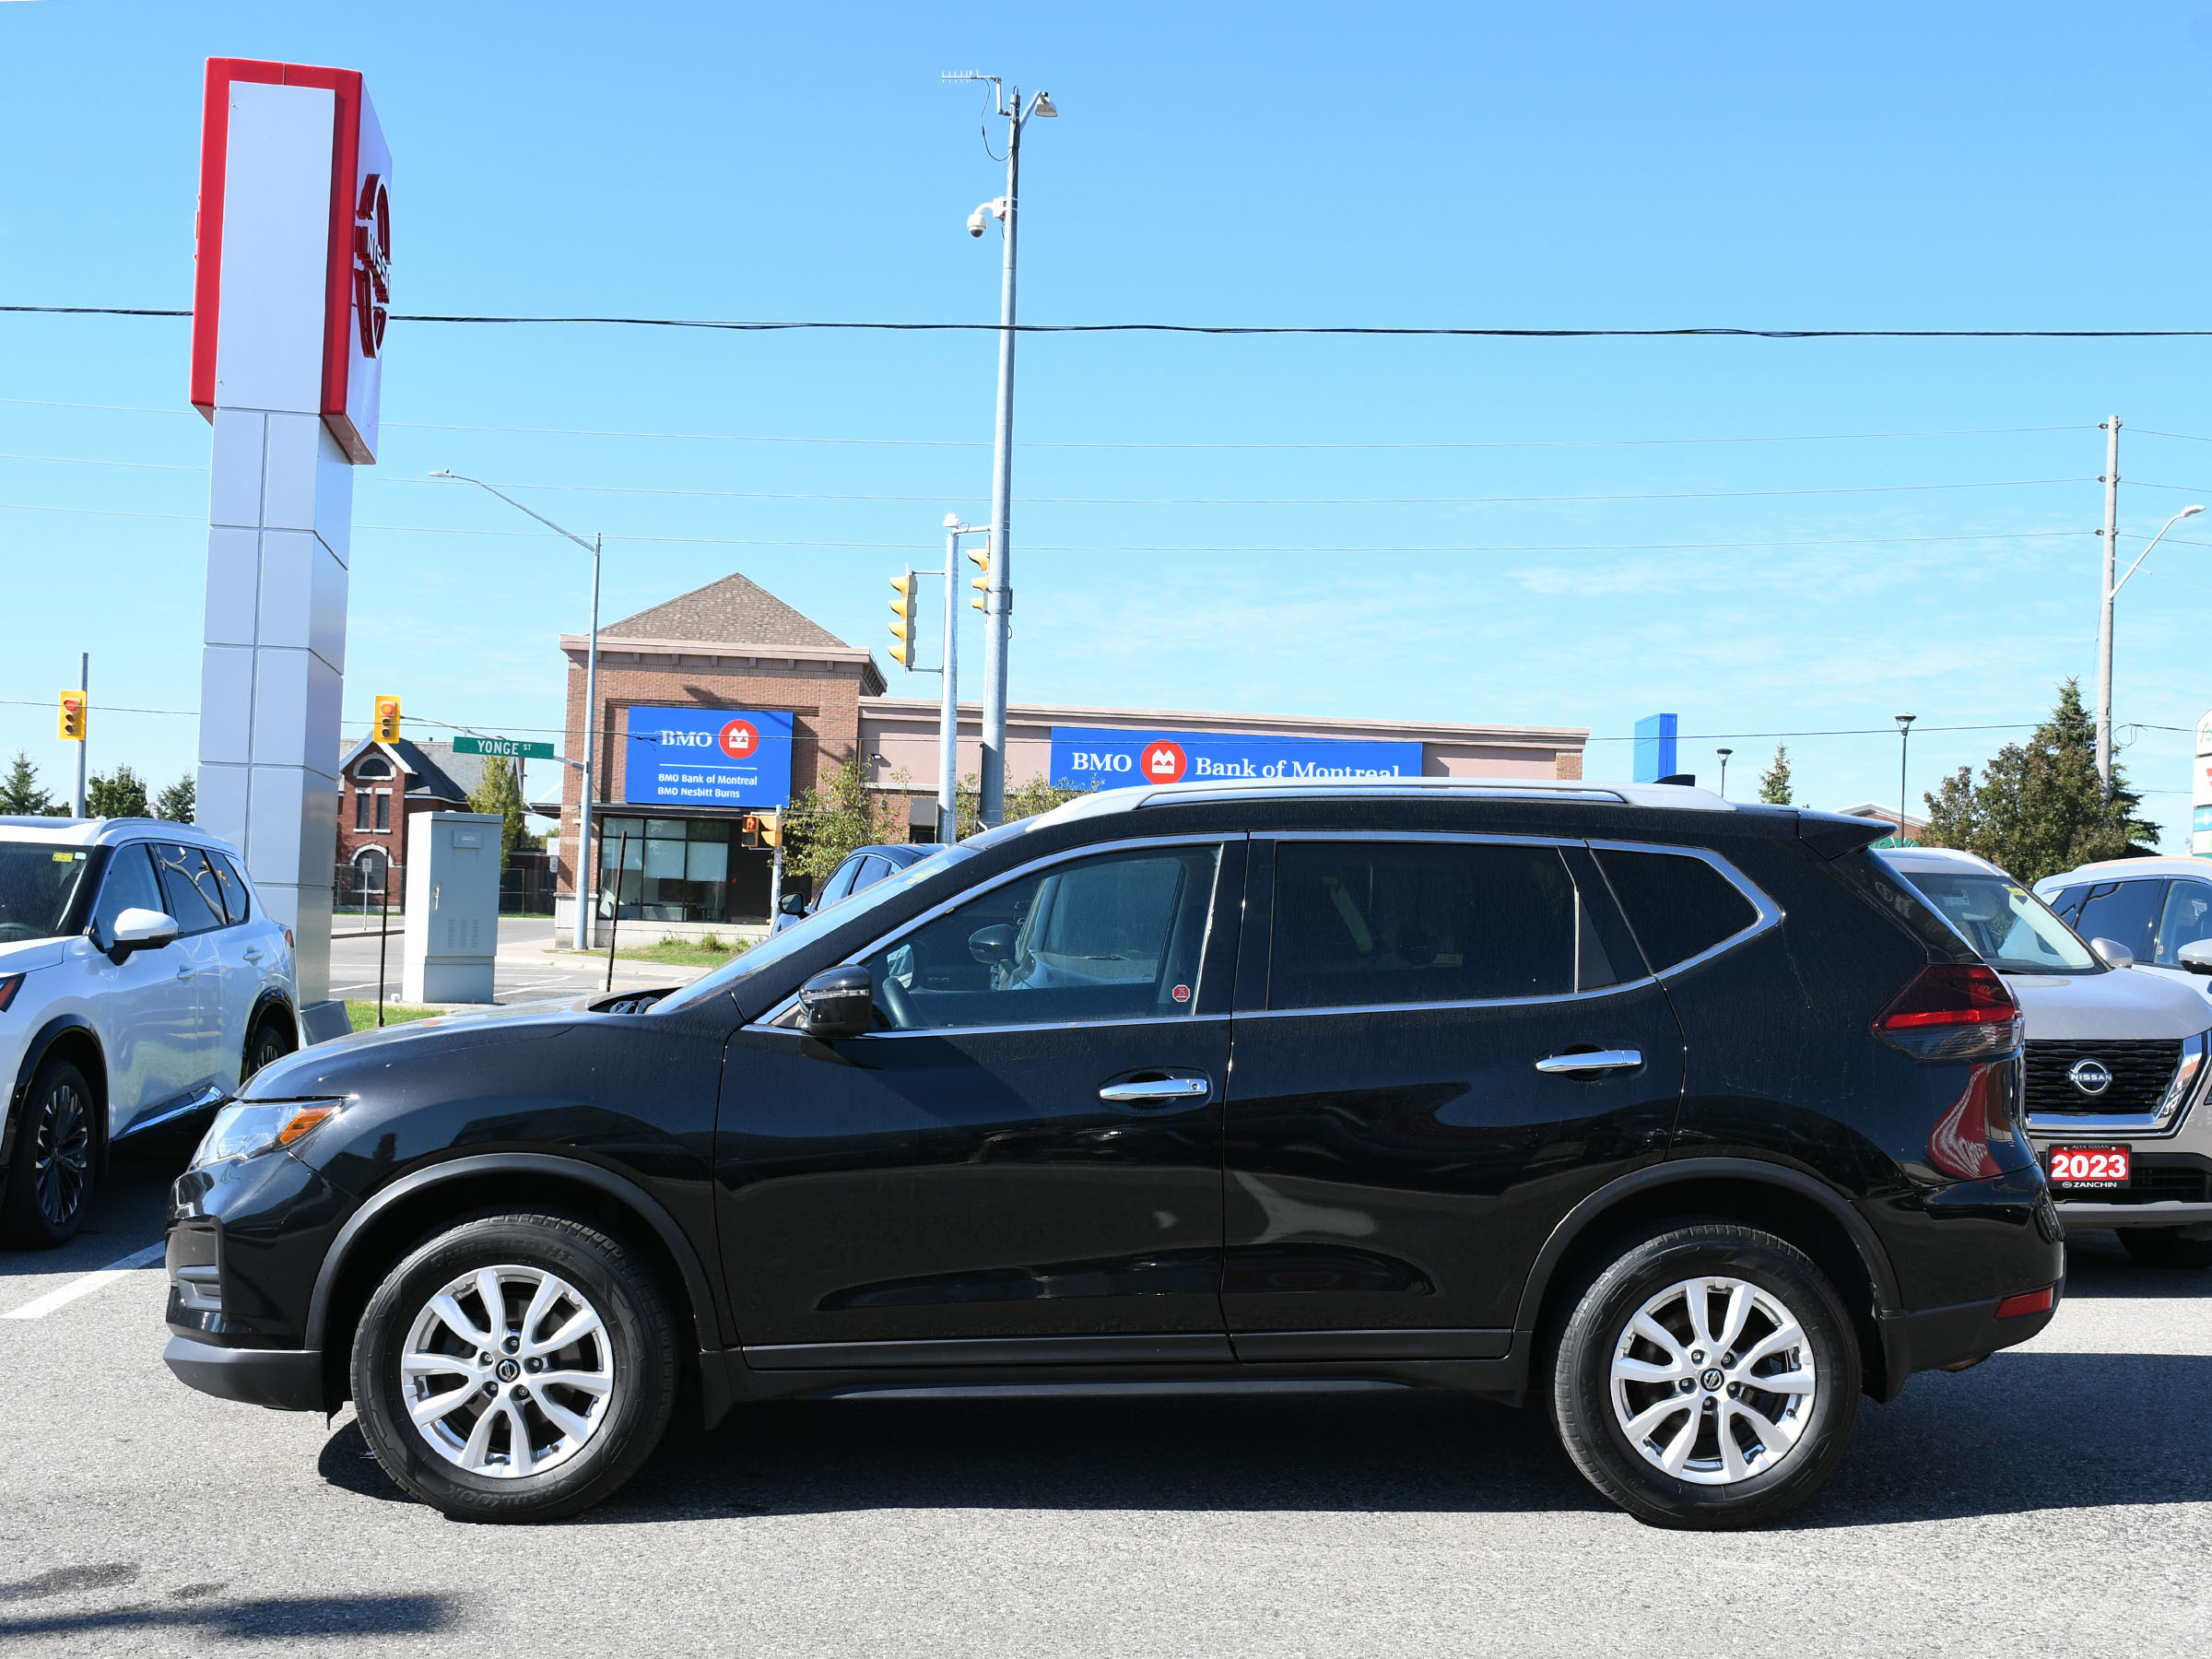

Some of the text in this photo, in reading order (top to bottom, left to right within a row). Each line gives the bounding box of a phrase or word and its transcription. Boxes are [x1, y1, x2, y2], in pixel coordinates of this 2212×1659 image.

[661, 730, 712, 747] BMO
[477, 740, 519, 755] YONGE
[1071, 752, 1400, 778] BMO Bank of Montreal
[658, 773, 758, 786] BMO Bank of Montreal
[657, 786, 741, 798] BMO Nesbitt Burns
[2051, 1154, 2126, 1178] 2023
